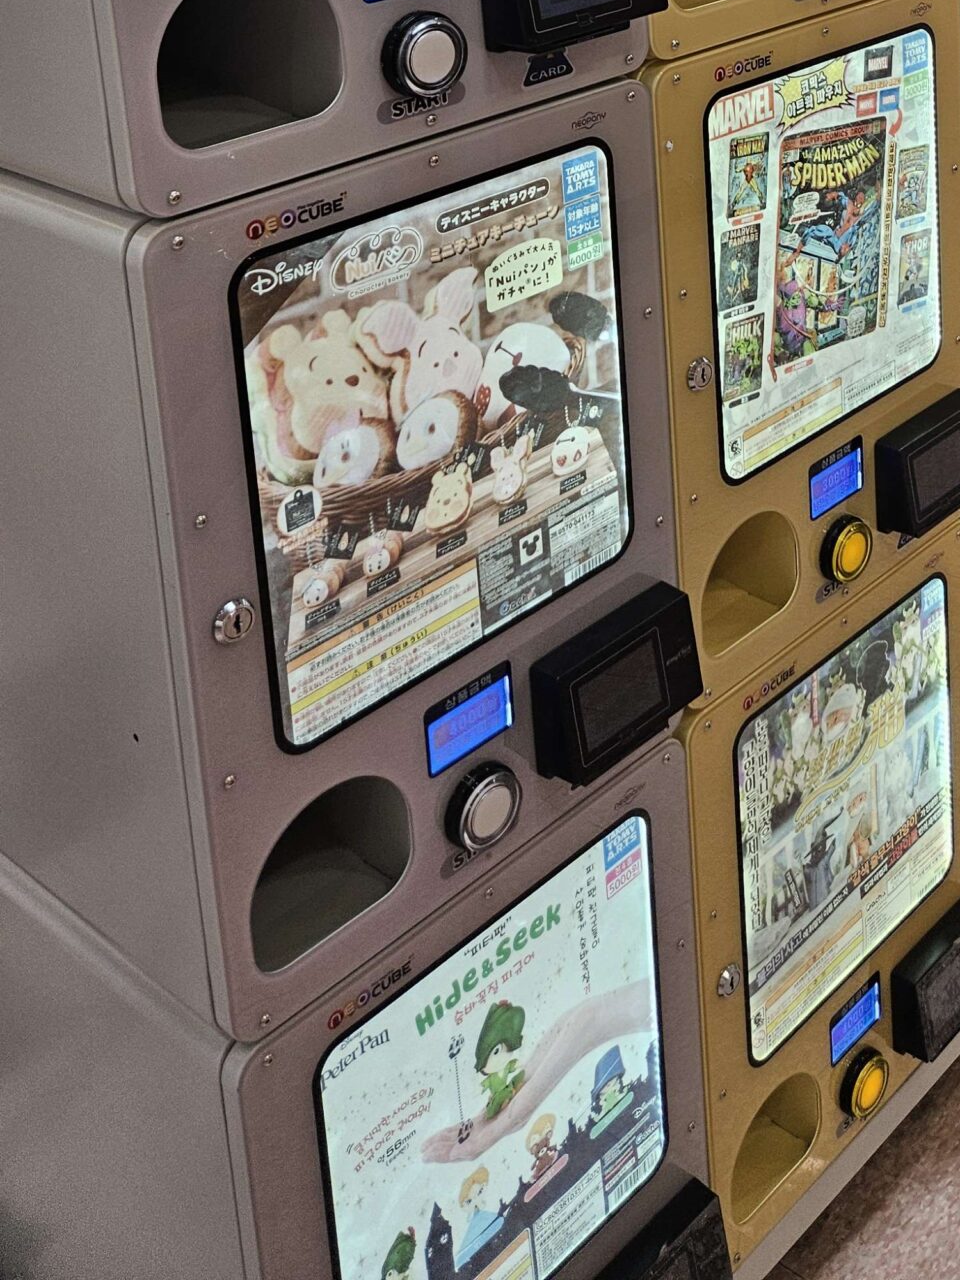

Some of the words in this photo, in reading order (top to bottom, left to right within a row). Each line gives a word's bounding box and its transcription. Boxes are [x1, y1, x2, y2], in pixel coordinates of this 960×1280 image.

[904, 46, 927, 58] TOMY
[529, 64, 567, 82] CARD
[800, 71, 828, 96] 코믹스
[391, 89, 451, 119] START
[708, 84, 774, 140] MARVEL
[812, 137, 866, 163] AMAZING
[565, 161, 595, 177] TAKARA
[566, 169, 595, 185] TOMY
[349, 281, 385, 299] Character
[606, 822, 637, 851] TOMY
[609, 861, 641, 895] 5000원
[414, 903, 562, 1037] Hide&Seek
[501, 951, 536, 983] 피규어
[320, 1052, 358, 1092] Peter
[357, 1027, 391, 1056] Pan
